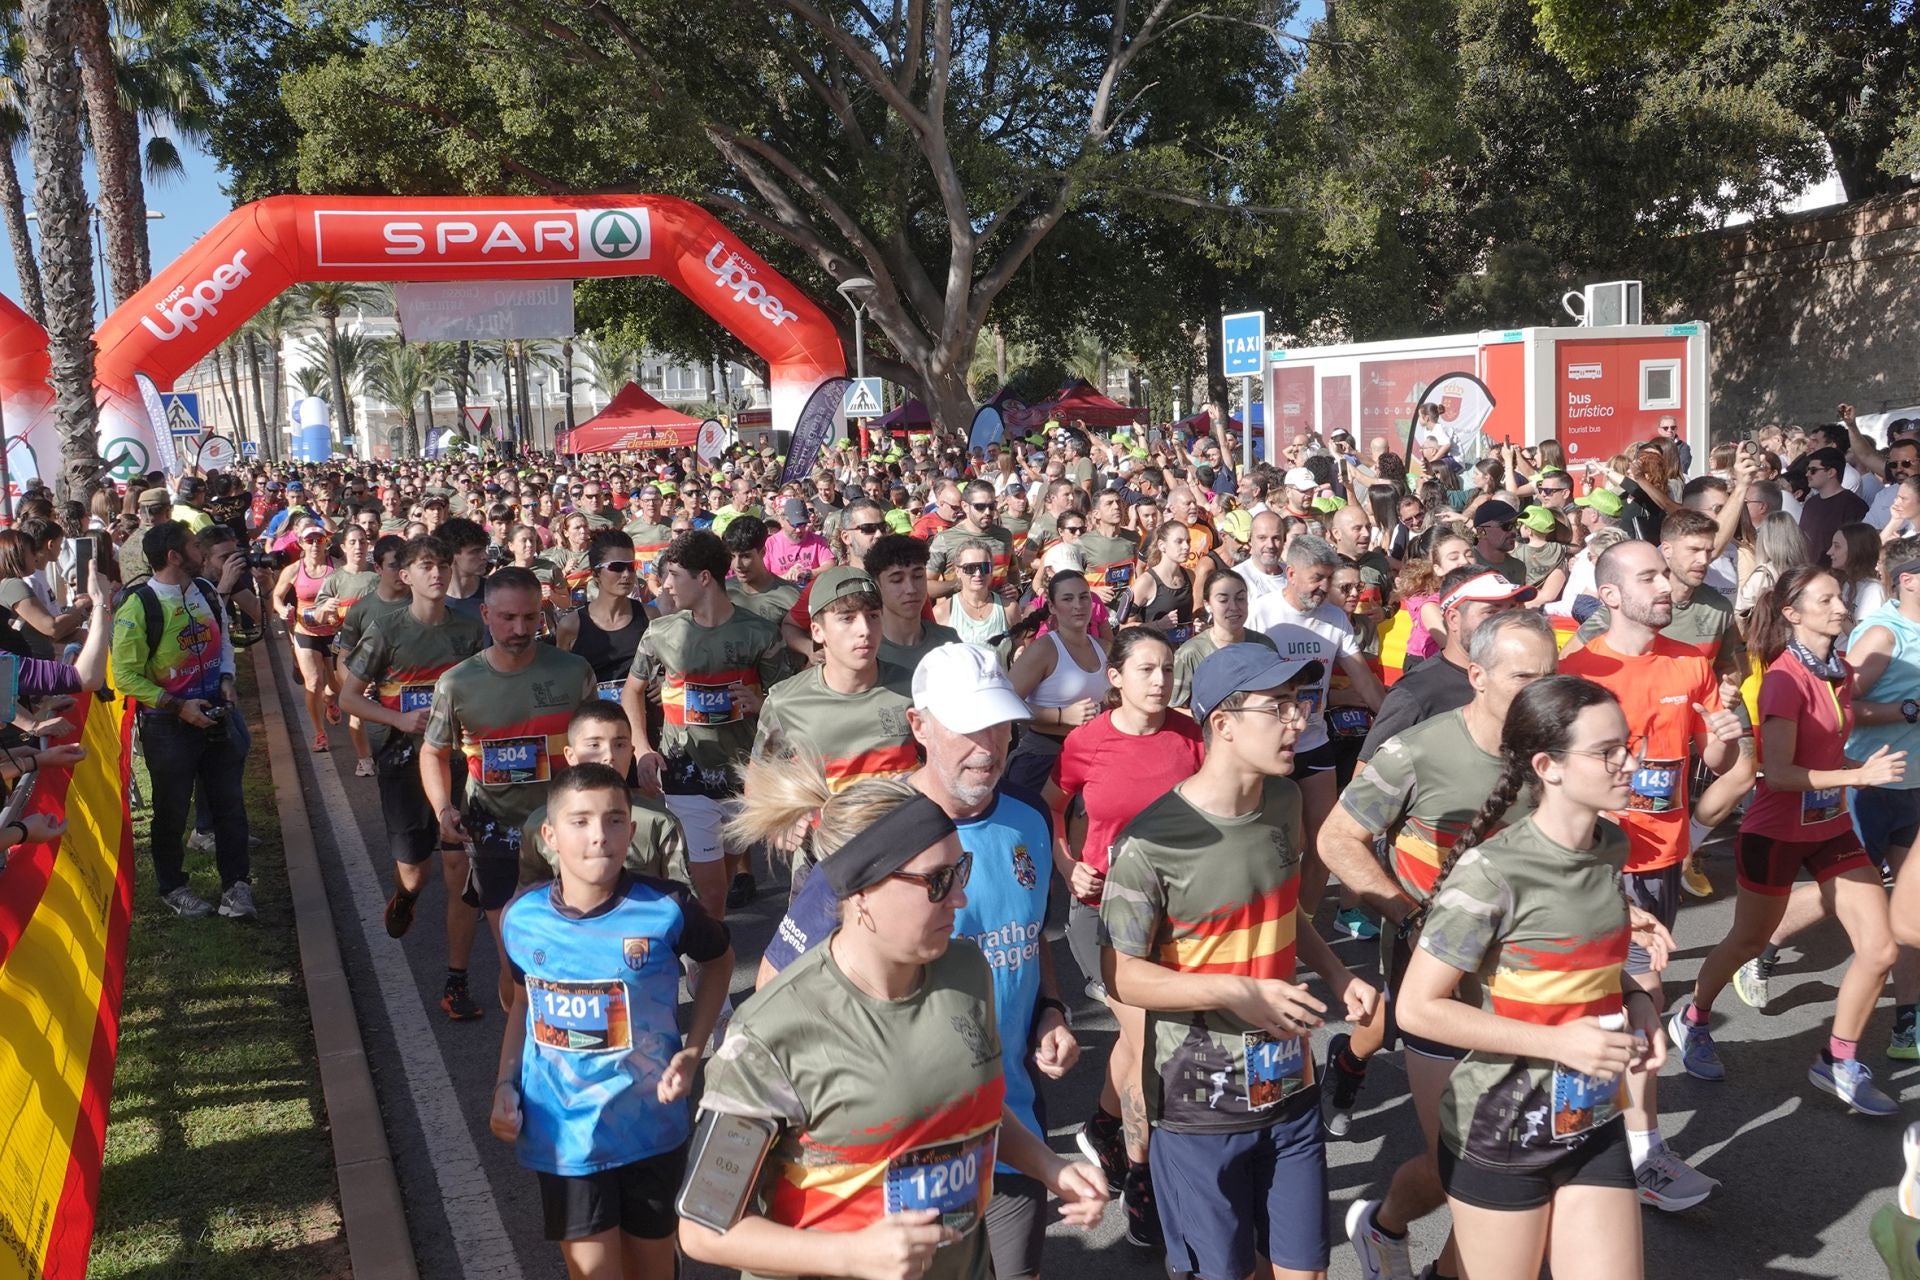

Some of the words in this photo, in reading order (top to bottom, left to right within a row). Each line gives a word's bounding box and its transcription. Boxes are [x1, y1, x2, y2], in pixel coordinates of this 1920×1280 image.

[383, 220, 575, 255] SPAR
[731, 251, 757, 275] grupo
[155, 285, 185, 312] grupo
[1226, 335, 1260, 354] TAXI
[1568, 392, 1592, 405] bus
[1568, 404, 1614, 418] turístico
[1568, 426, 1588, 434] tourist
[1589, 425, 1601, 433] bus
[1287, 641, 1322, 655] UNED
[698, 692, 724, 706] 124
[1342, 710, 1361, 722] 617
[497, 746, 527, 762] 504
[544, 992, 600, 1019] 1201
[1259, 1034, 1301, 1069] 1444
[909, 1152, 976, 1201] 1200
